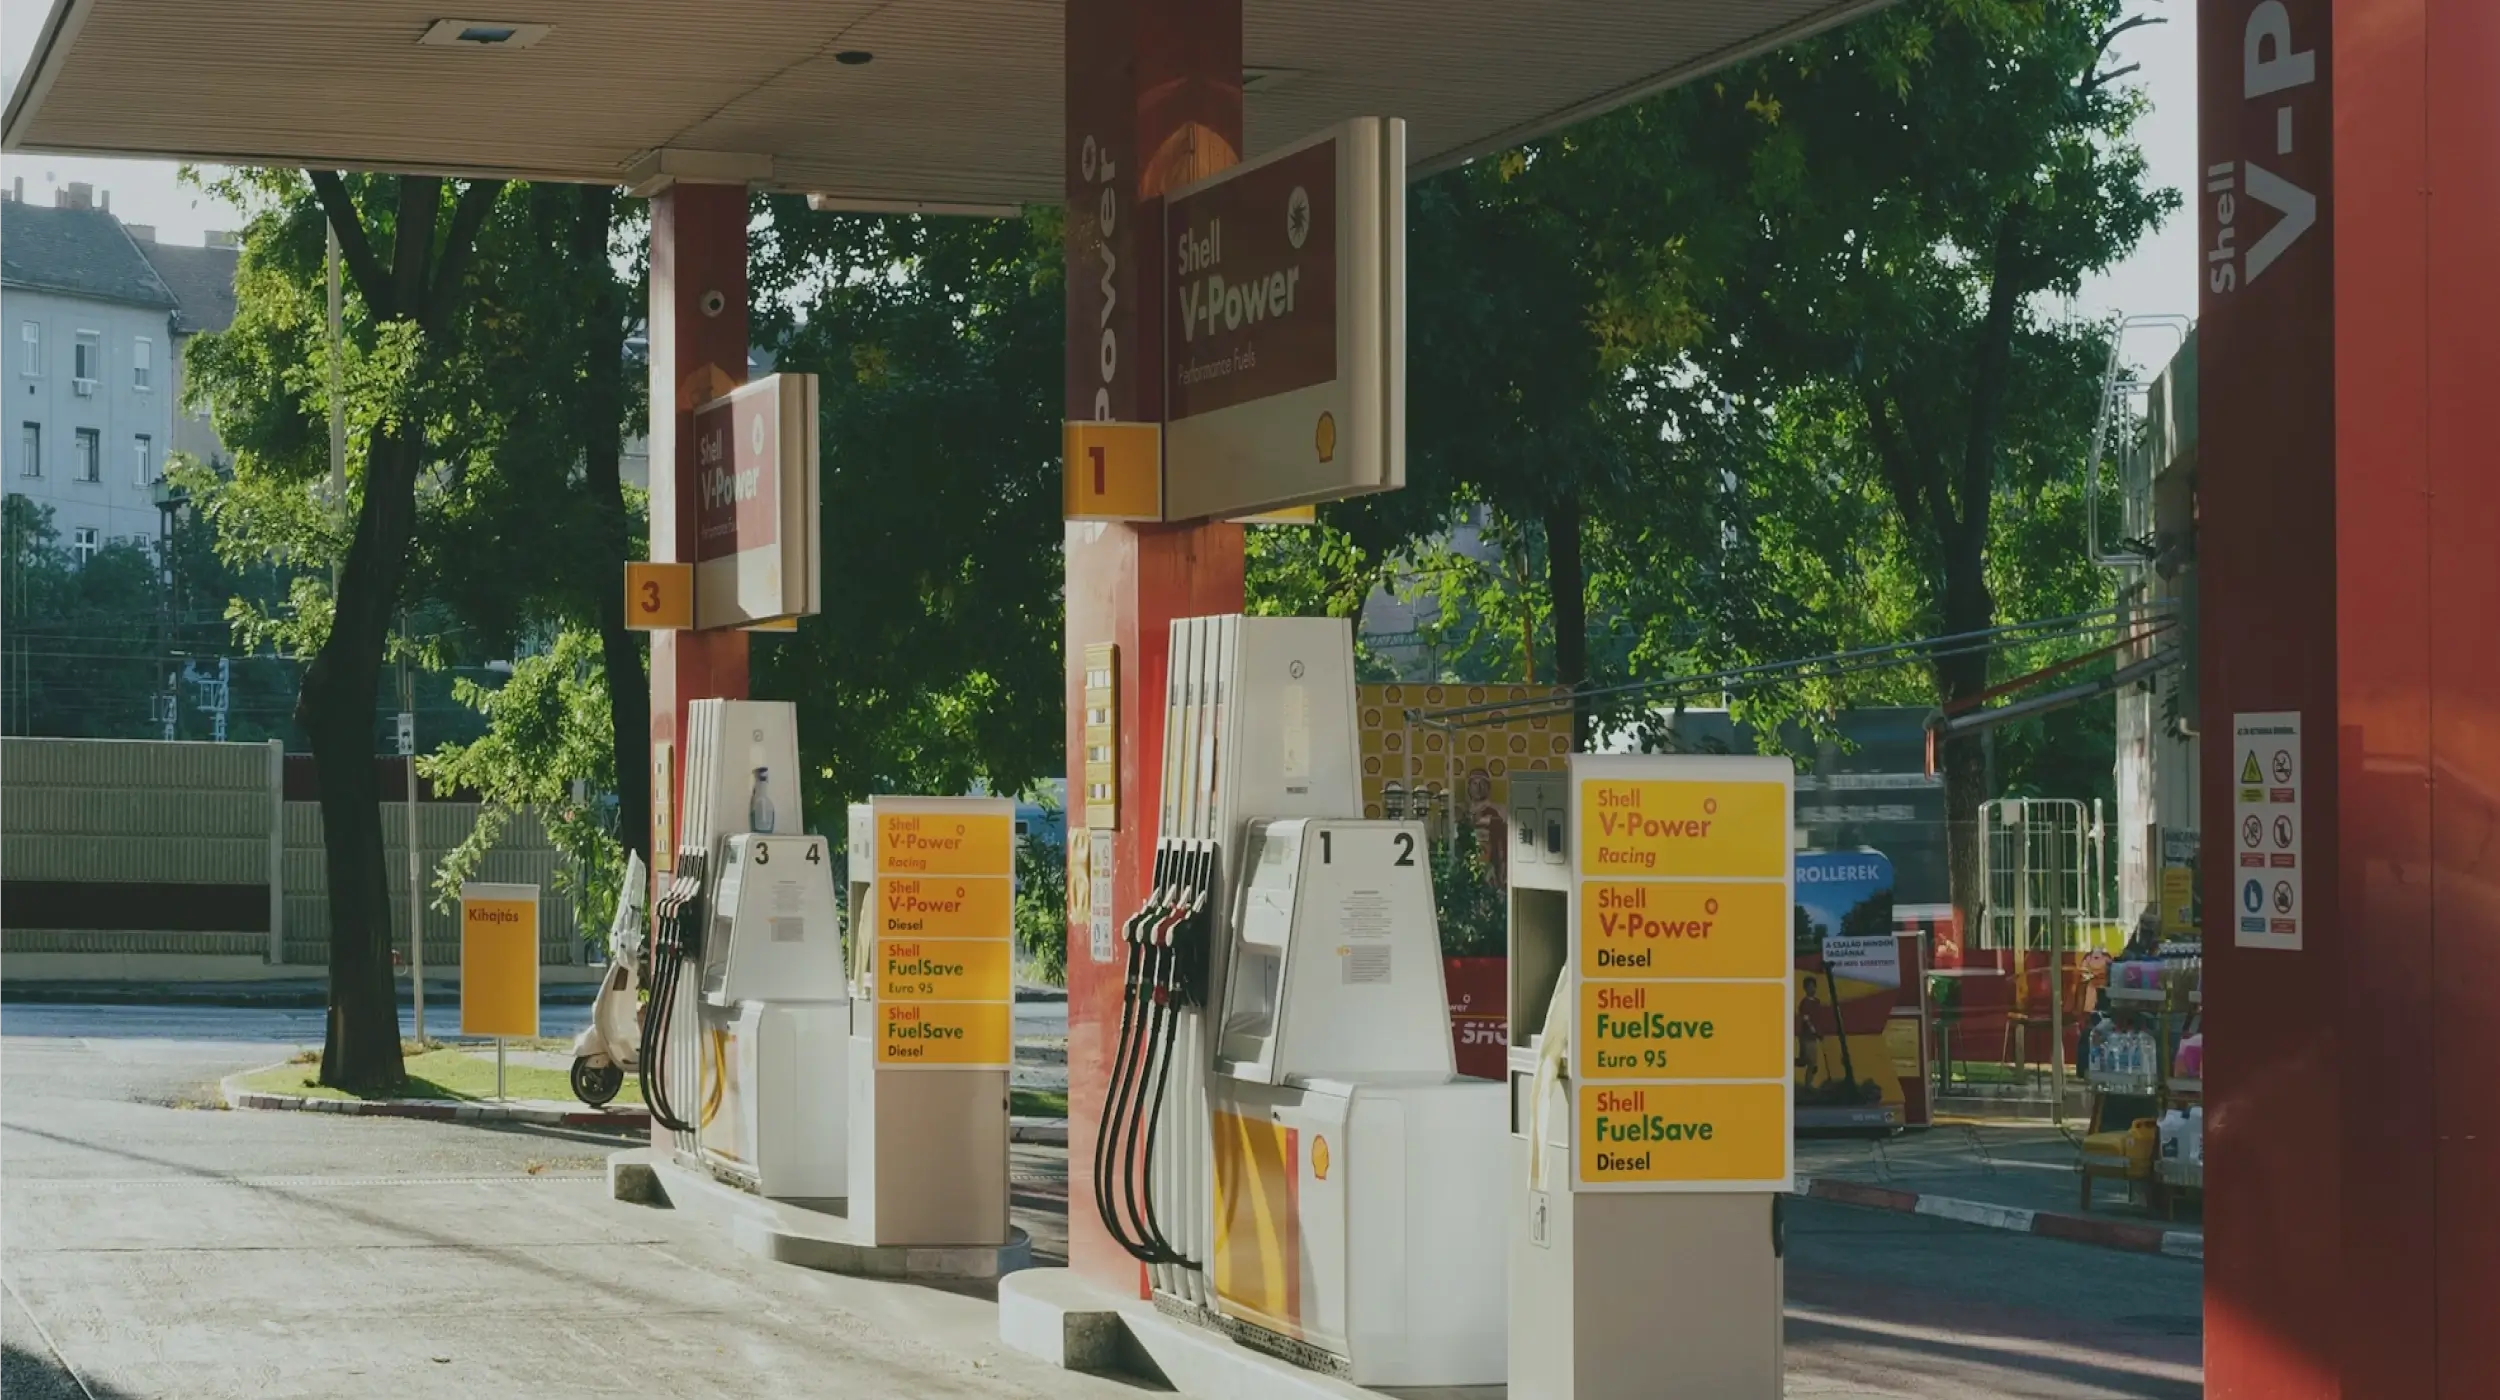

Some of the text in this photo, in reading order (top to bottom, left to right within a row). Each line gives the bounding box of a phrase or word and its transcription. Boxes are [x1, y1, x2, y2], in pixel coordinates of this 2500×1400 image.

[2207, 161, 2235, 294] Shell
[1178, 218, 1220, 275] Shell
[1180, 266, 1298, 342] V-Power
[700, 429, 723, 465] Shell
[1088, 446, 1105, 495] 1
[702, 467, 759, 510] V-Power
[641, 580, 661, 613] 3
[1597, 788, 1641, 808] Shell
[888, 817, 920, 832] Shell
[1599, 811, 1711, 838] V-Power
[887, 833, 963, 851] V-Power
[1319, 831, 1415, 866] 1 2
[754, 841, 821, 865] 3 4
[887, 856, 927, 871] Racing
[1597, 846, 1656, 868] Racing
[1796, 865, 1880, 883] ROLLEREK
[888, 880, 920, 895] Shell
[1598, 887, 1646, 909] Shell
[888, 896, 962, 914] V-Power
[469, 908, 518, 924] Kihajtás
[887, 918, 923, 931] Diesel
[1599, 912, 1713, 939] V-Power
[888, 944, 920, 958] Shell
[1597, 948, 1651, 968] Diesel
[888, 959, 964, 977] FuelSave
[888, 982, 934, 994] Euro 95
[1597, 988, 1646, 1009] Shell
[888, 1006, 920, 1021] Shell
[888, 1022, 964, 1040] FuelSave
[1596, 1011, 1714, 1040] FuelSave
[887, 1044, 924, 1058] Diesel
[1597, 1049, 1667, 1069] Euro 95
[1596, 1091, 1645, 1113] Shell
[1596, 1113, 1714, 1142] FuelSave
[1596, 1151, 1651, 1172] Diesel
